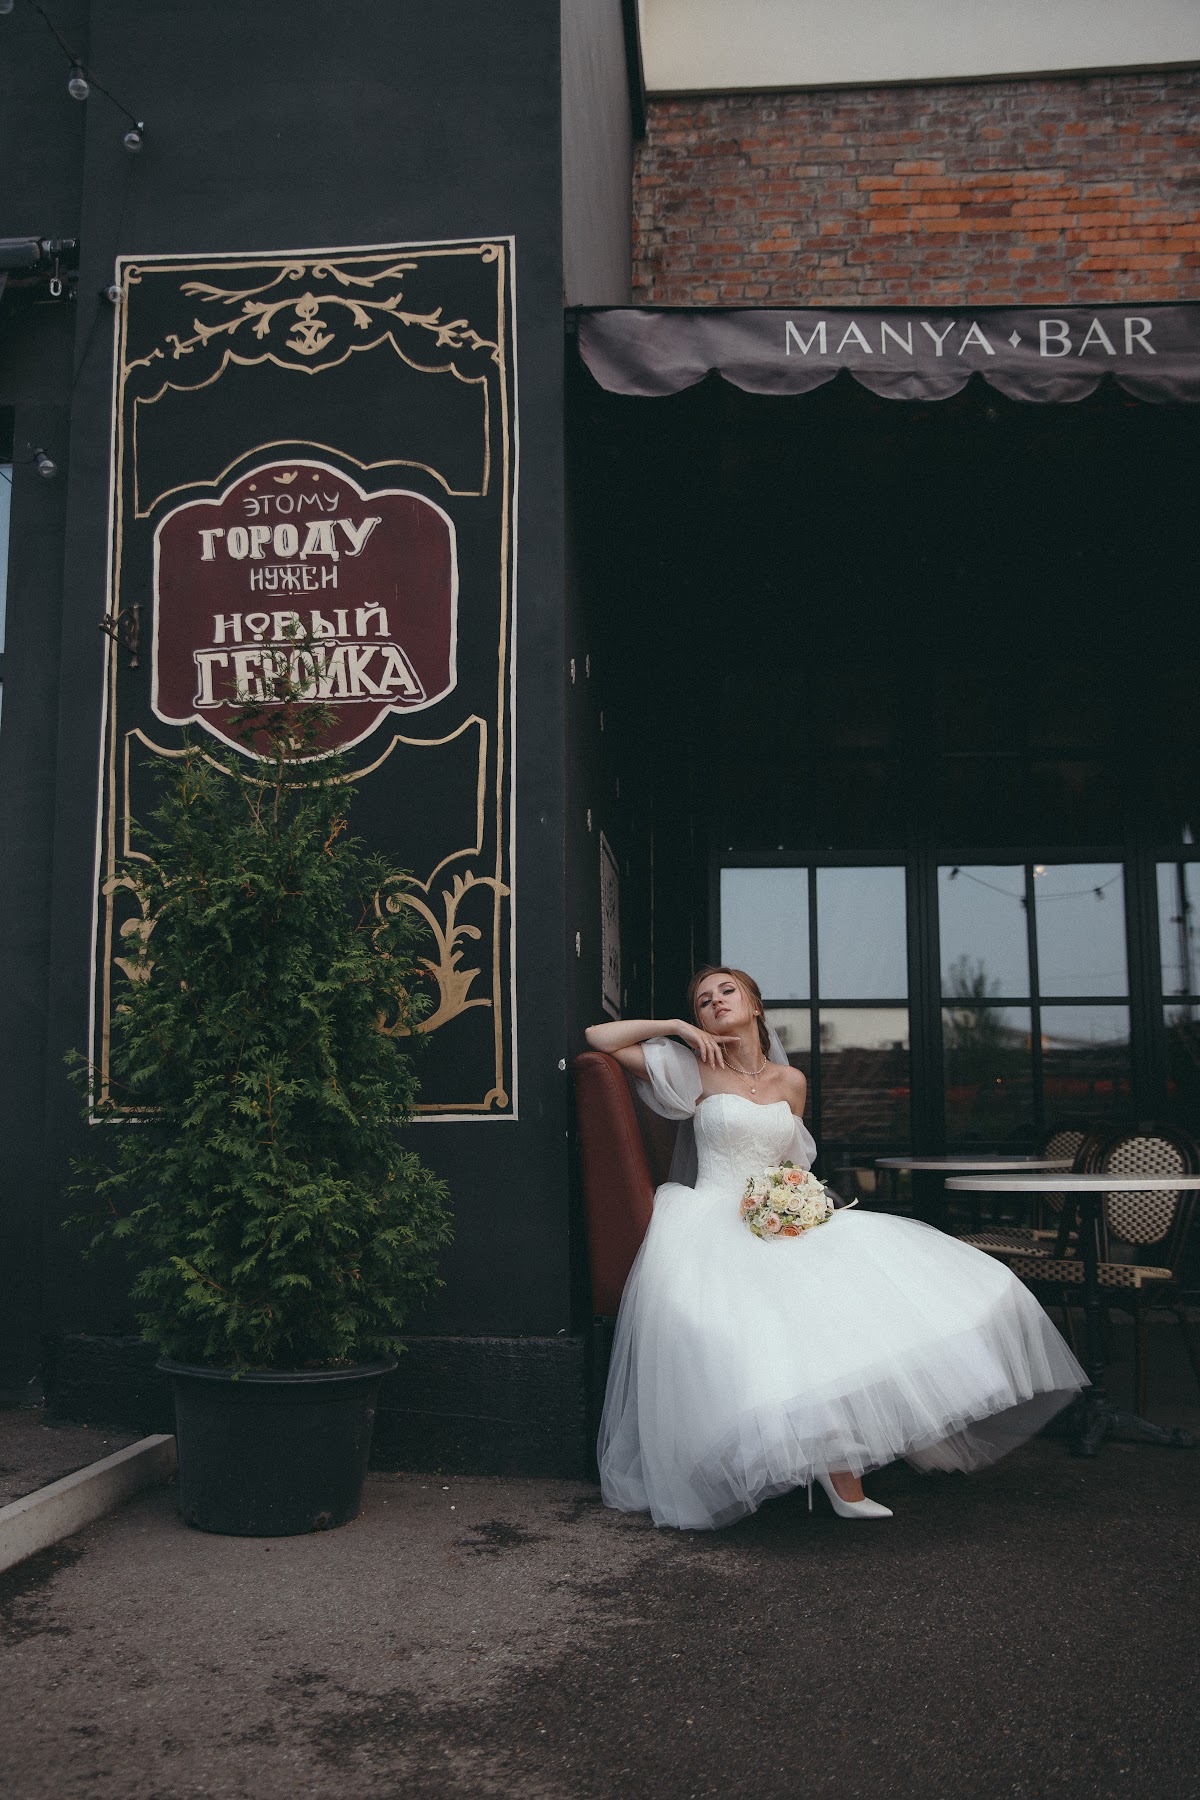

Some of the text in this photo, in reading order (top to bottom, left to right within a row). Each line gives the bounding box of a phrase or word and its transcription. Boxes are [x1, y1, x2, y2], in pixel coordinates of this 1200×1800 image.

[785, 317, 1157, 357] MANYA BAR
[243, 491, 340, 516] ЭТОМУ
[198, 517, 382, 562] ГОРОДУ
[250, 565, 338, 591] НУЖЕН
[212, 601, 392, 643] НОВЫЙ
